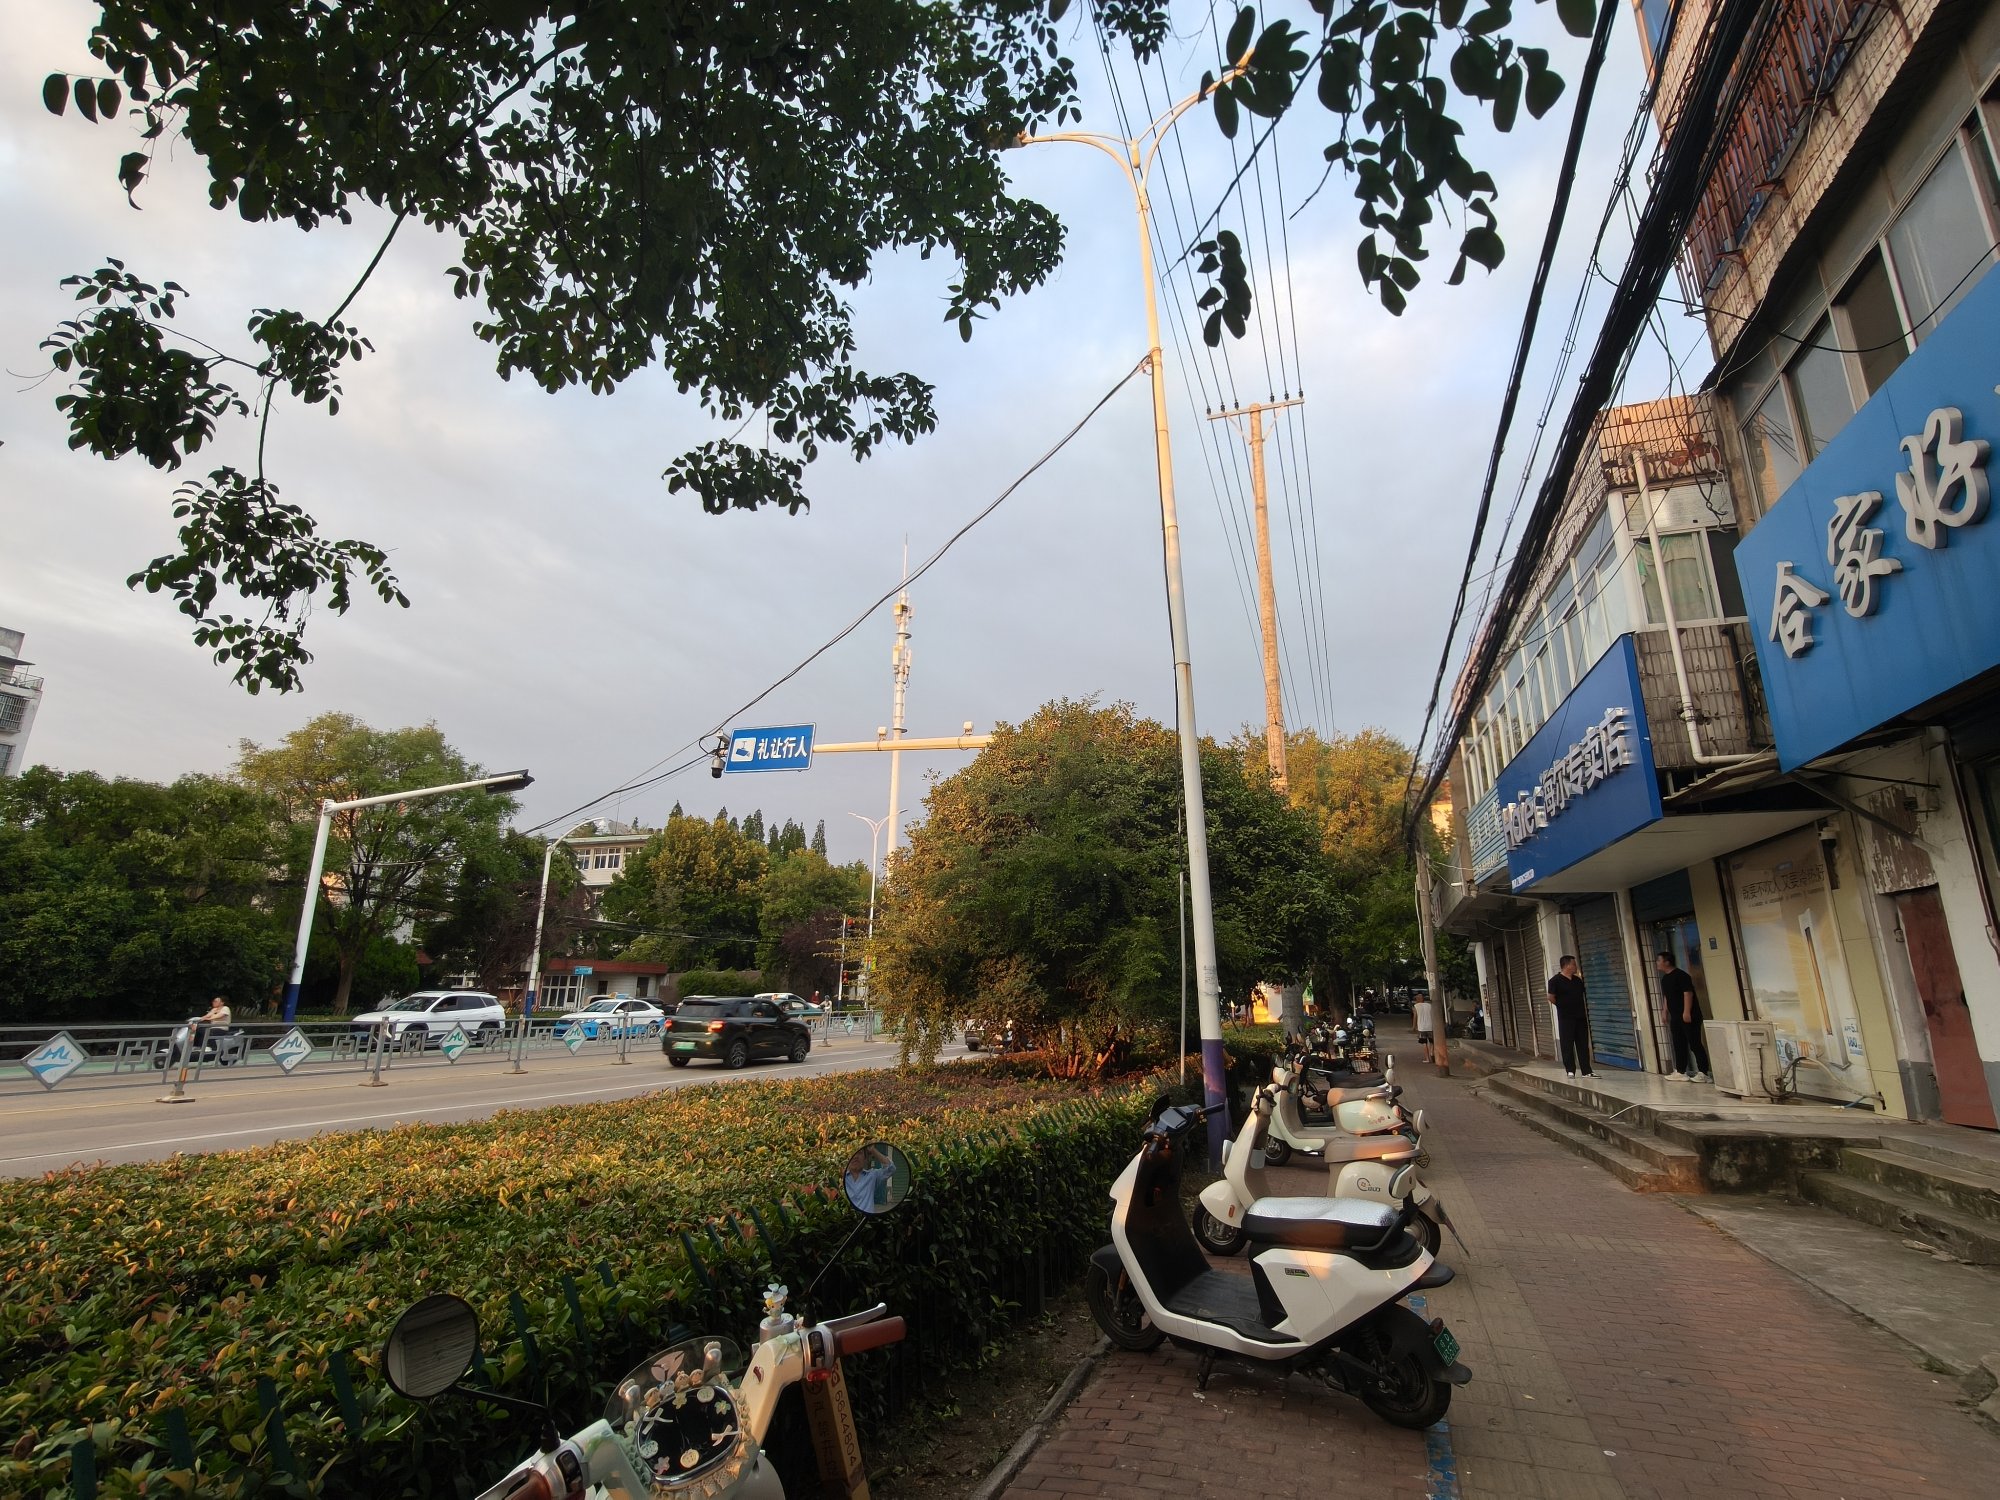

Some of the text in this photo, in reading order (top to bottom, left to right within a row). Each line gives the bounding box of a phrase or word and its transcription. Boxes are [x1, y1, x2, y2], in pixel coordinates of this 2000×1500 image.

[1768, 384, 2000, 659] 合家好
[757, 735, 808, 760] 礼让行人
[1540, 707, 1636, 817] 海尔专卖店
